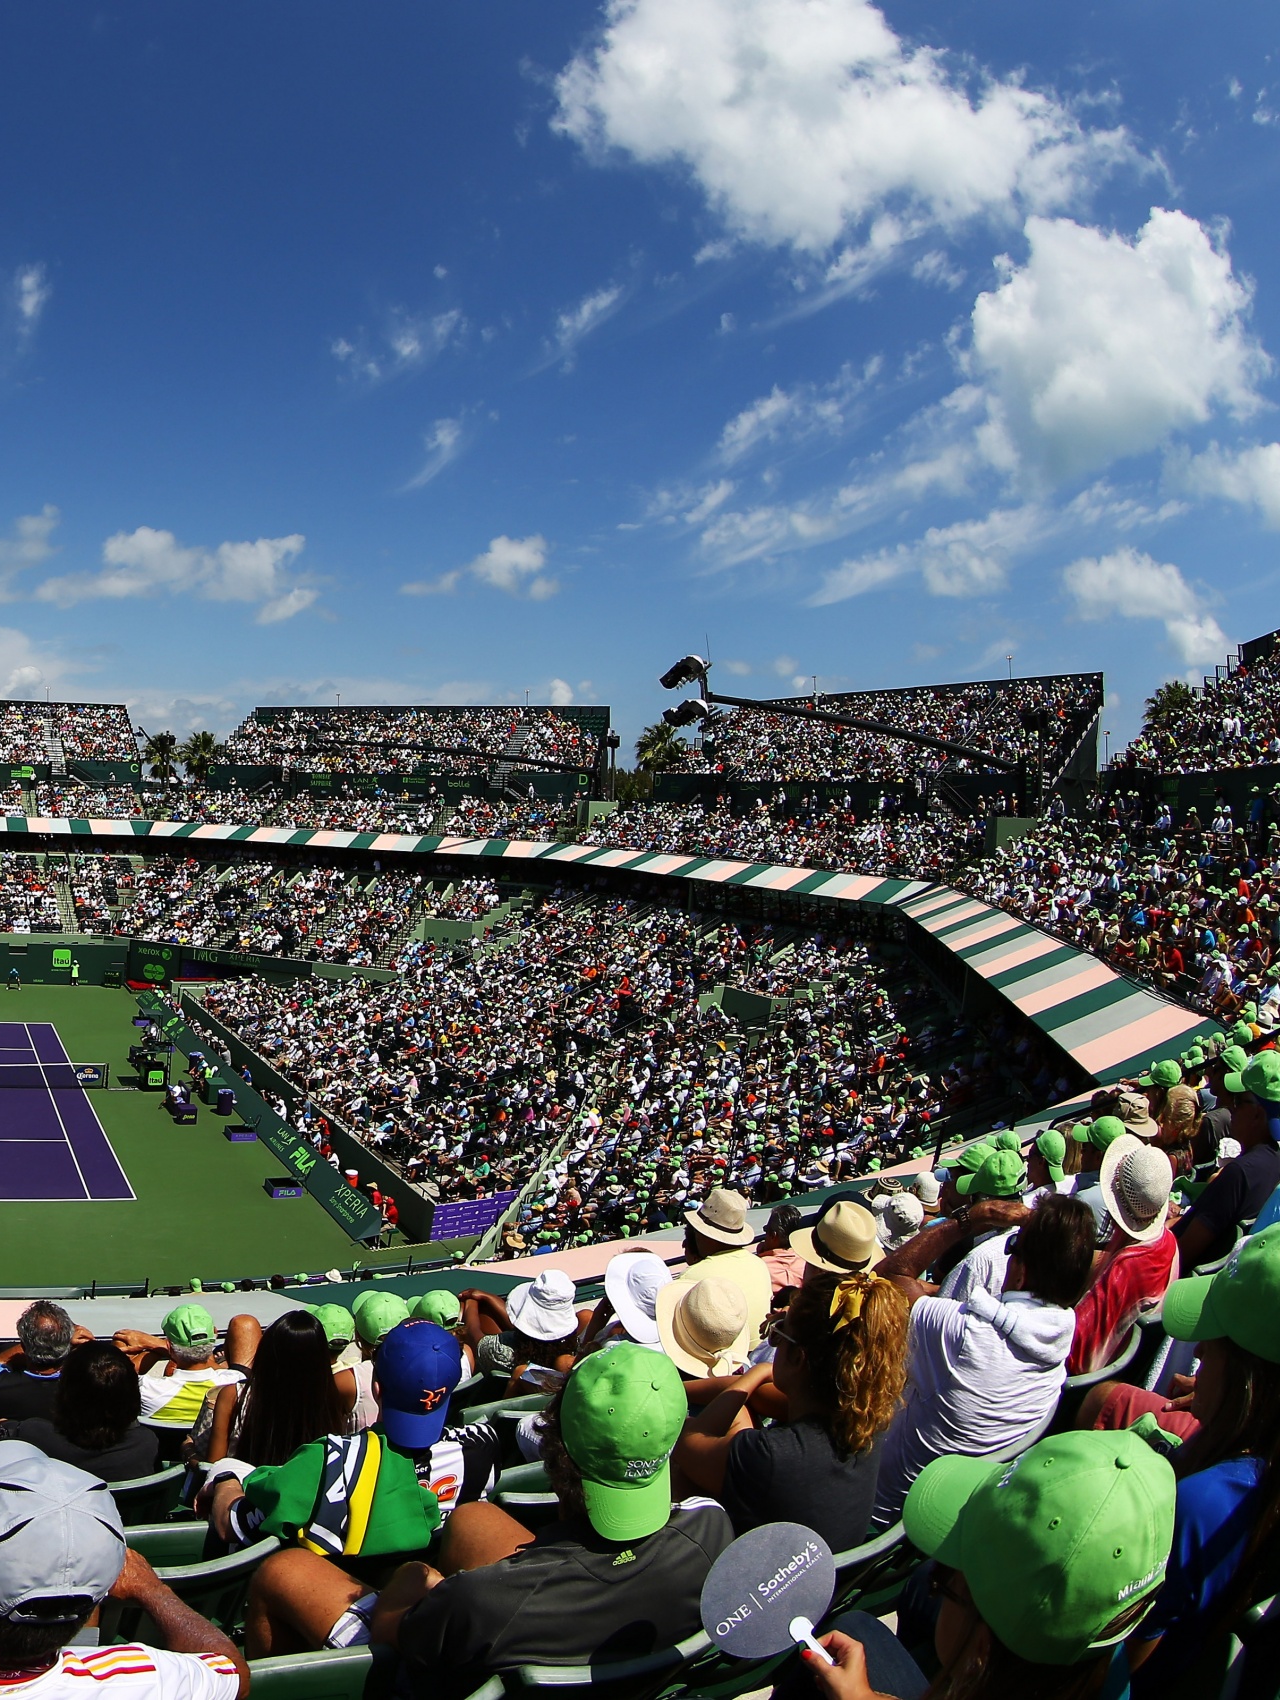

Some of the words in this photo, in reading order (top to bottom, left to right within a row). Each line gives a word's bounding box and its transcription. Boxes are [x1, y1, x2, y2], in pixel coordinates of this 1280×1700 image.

[131, 763, 138, 773] C
[208, 766, 216, 776] C
[578, 774, 588, 786] D
[654, 775, 662, 787] D
[137, 947, 161, 957] xerox
[192, 949, 218, 963] IMG
[53, 957, 70, 965] Itaú
[229, 953, 261, 964] XPERIA
[76, 1071, 99, 1080] Corona
[277, 1127, 290, 1142] LAN
[289, 1146, 317, 1174] FILA
[334, 1183, 369, 1219] XPERIA
[627, 1457, 659, 1469] SONY
[612, 1555, 637, 1566] adidas
[767, 1568, 807, 1604] INTERNATIONAL
[805, 1552, 823, 1570] REALTY
[716, 1603, 752, 1637] ONE
[757, 1541, 819, 1598] Sotheby's
